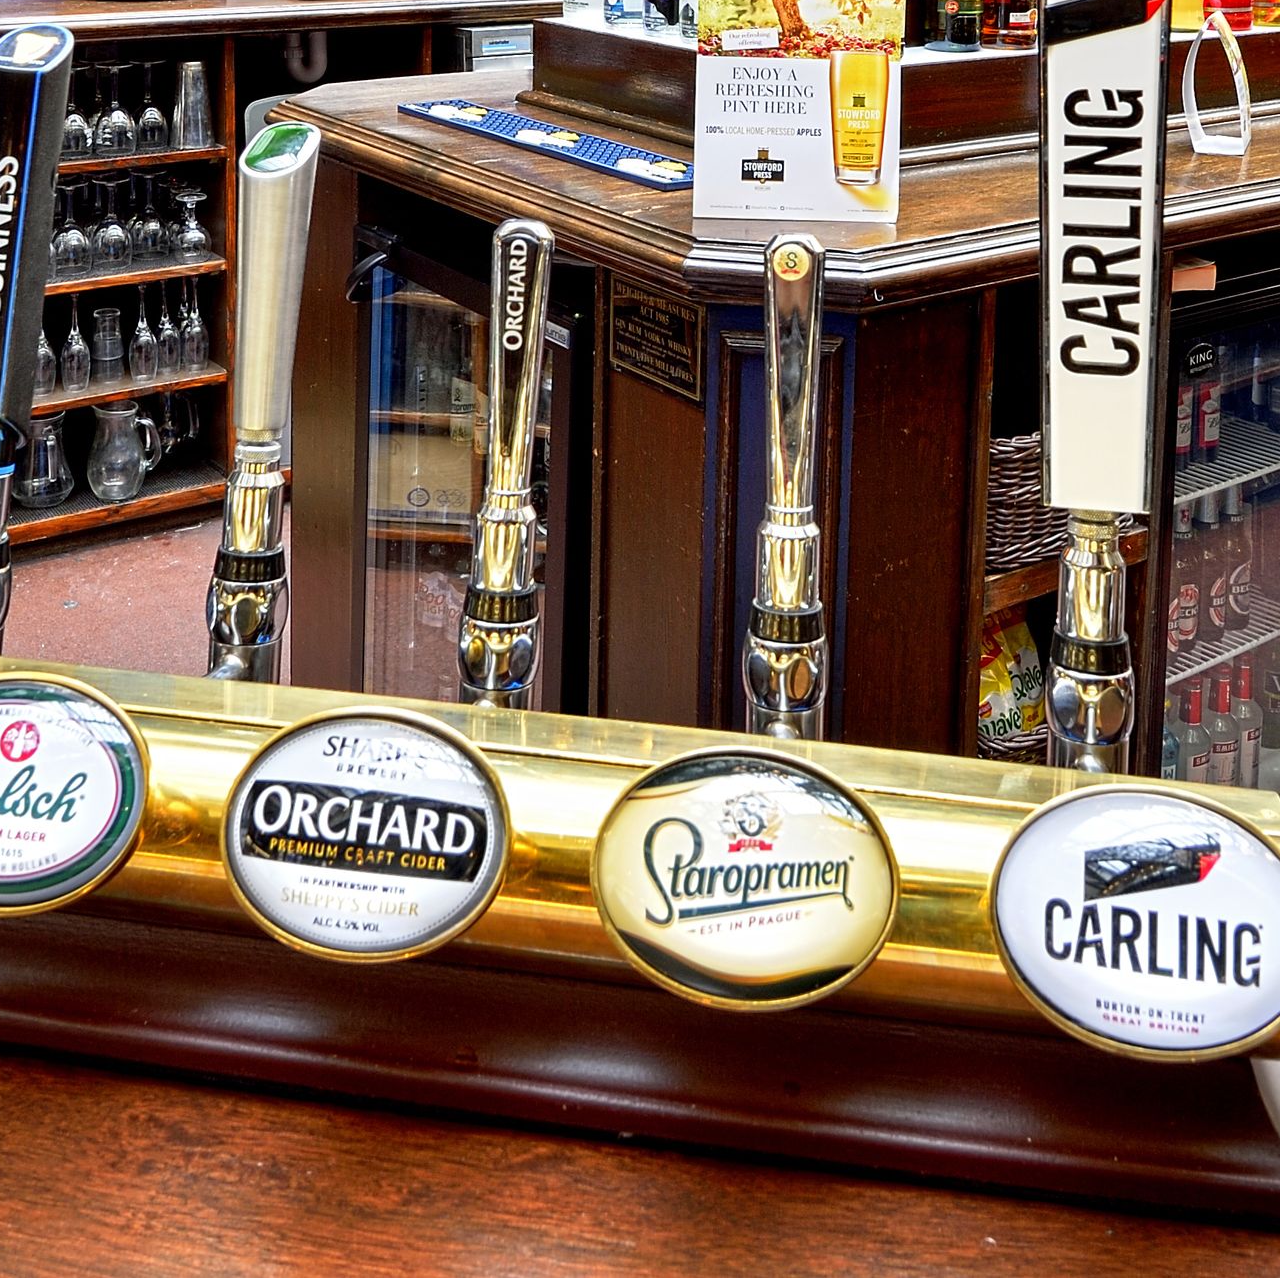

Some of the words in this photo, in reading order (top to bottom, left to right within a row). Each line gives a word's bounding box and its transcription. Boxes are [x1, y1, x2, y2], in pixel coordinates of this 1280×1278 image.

[732, 66, 782, 81] ENJOY
[787, 68, 798, 81] A
[715, 83, 814, 99] REFRESHING
[722, 100, 760, 113] PINT
[764, 101, 807, 115] HERE
[837, 109, 881, 120] STOWFORD
[705, 125, 724, 134] 100%
[725, 126, 745, 135] LOCAL
[746, 126, 795, 136] HOME-PRESSED
[796, 128, 822, 137] APPLES
[848, 120, 870, 129] PRESS
[743, 162, 783, 172] STOWFORD
[1059, 87, 1144, 377] CARLING
[502, 238, 528, 351] ORCHARD
[639, 305, 653, 319] ACT
[1189, 349, 1213, 366] KING
[336, 763, 407, 781] BREWERY
[253, 784, 475, 855] ORCHARD
[7, 829, 46, 842] LAGER
[1, 847, 23, 858] 1615
[269, 837, 339, 858] PREMIUM
[344, 846, 395, 865] CRAFT
[400, 854, 446, 871] CIDER
[11, 852, 58, 872] HOLLAND
[644, 817, 854, 927] Staropramen
[299, 876, 309, 885] IN
[312, 877, 378, 893] PARTNERSHIP
[381, 886, 406, 895] WITH
[280, 887, 360, 912] SHEPPY'S
[366, 896, 419, 917] CIDER
[312, 917, 332, 928] ALC
[699, 923, 721, 935] EST
[729, 919, 743, 931] IN
[748, 910, 802, 928] PRAGUE
[1044, 897, 1261, 988] CARLING
[1102, 1013, 1141, 1027] GREAT
[1149, 1021, 1200, 1034] BRITAIN
